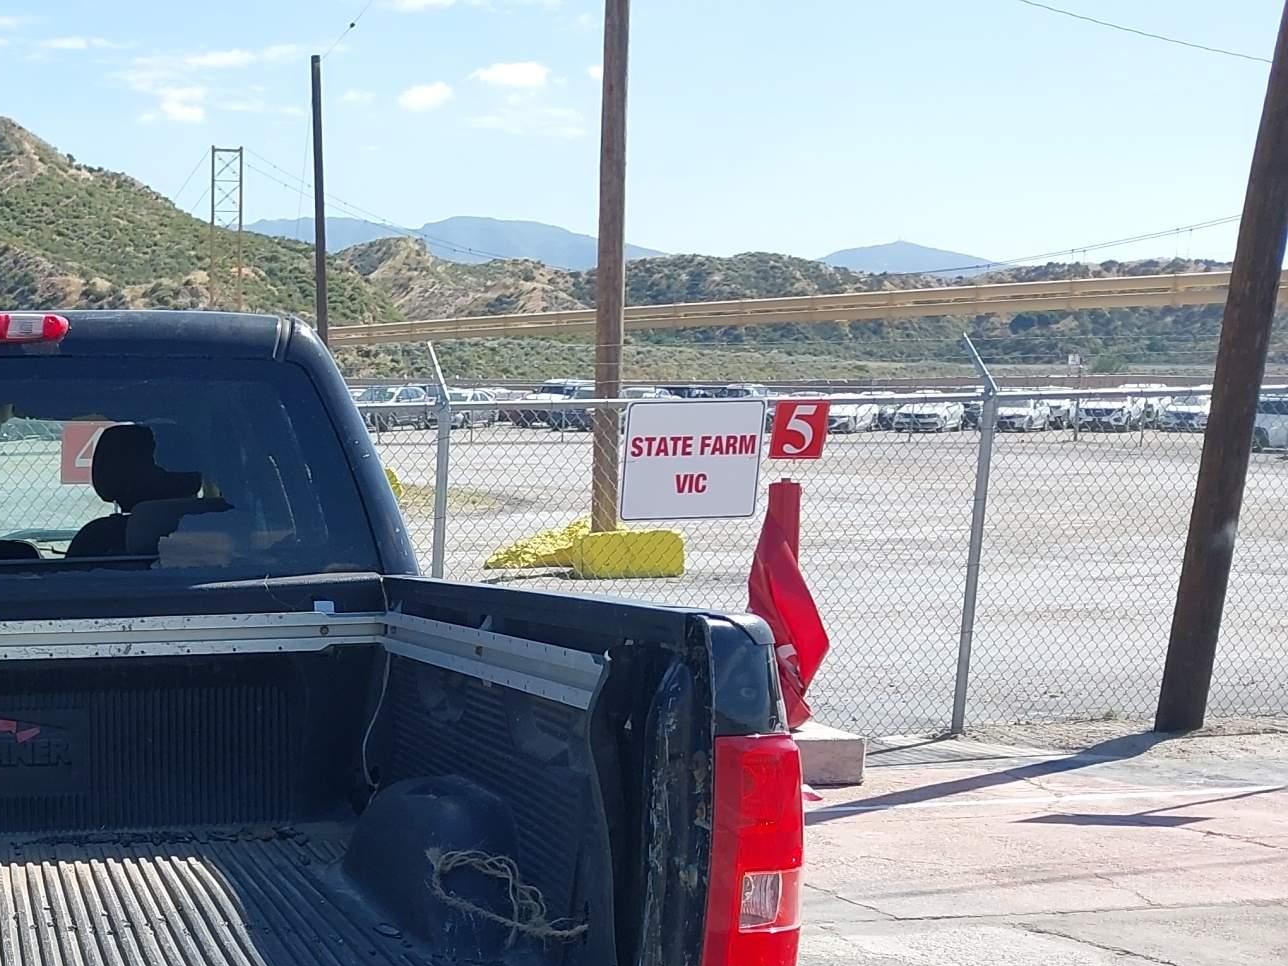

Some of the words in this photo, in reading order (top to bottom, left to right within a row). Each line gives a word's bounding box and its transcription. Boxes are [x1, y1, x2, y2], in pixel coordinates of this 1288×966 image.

[781, 404, 817, 455] 5
[75, 427, 105, 467] 4
[630, 436, 693, 458] STATE
[699, 434, 757, 456] FARM
[675, 473, 708, 494] VIC
